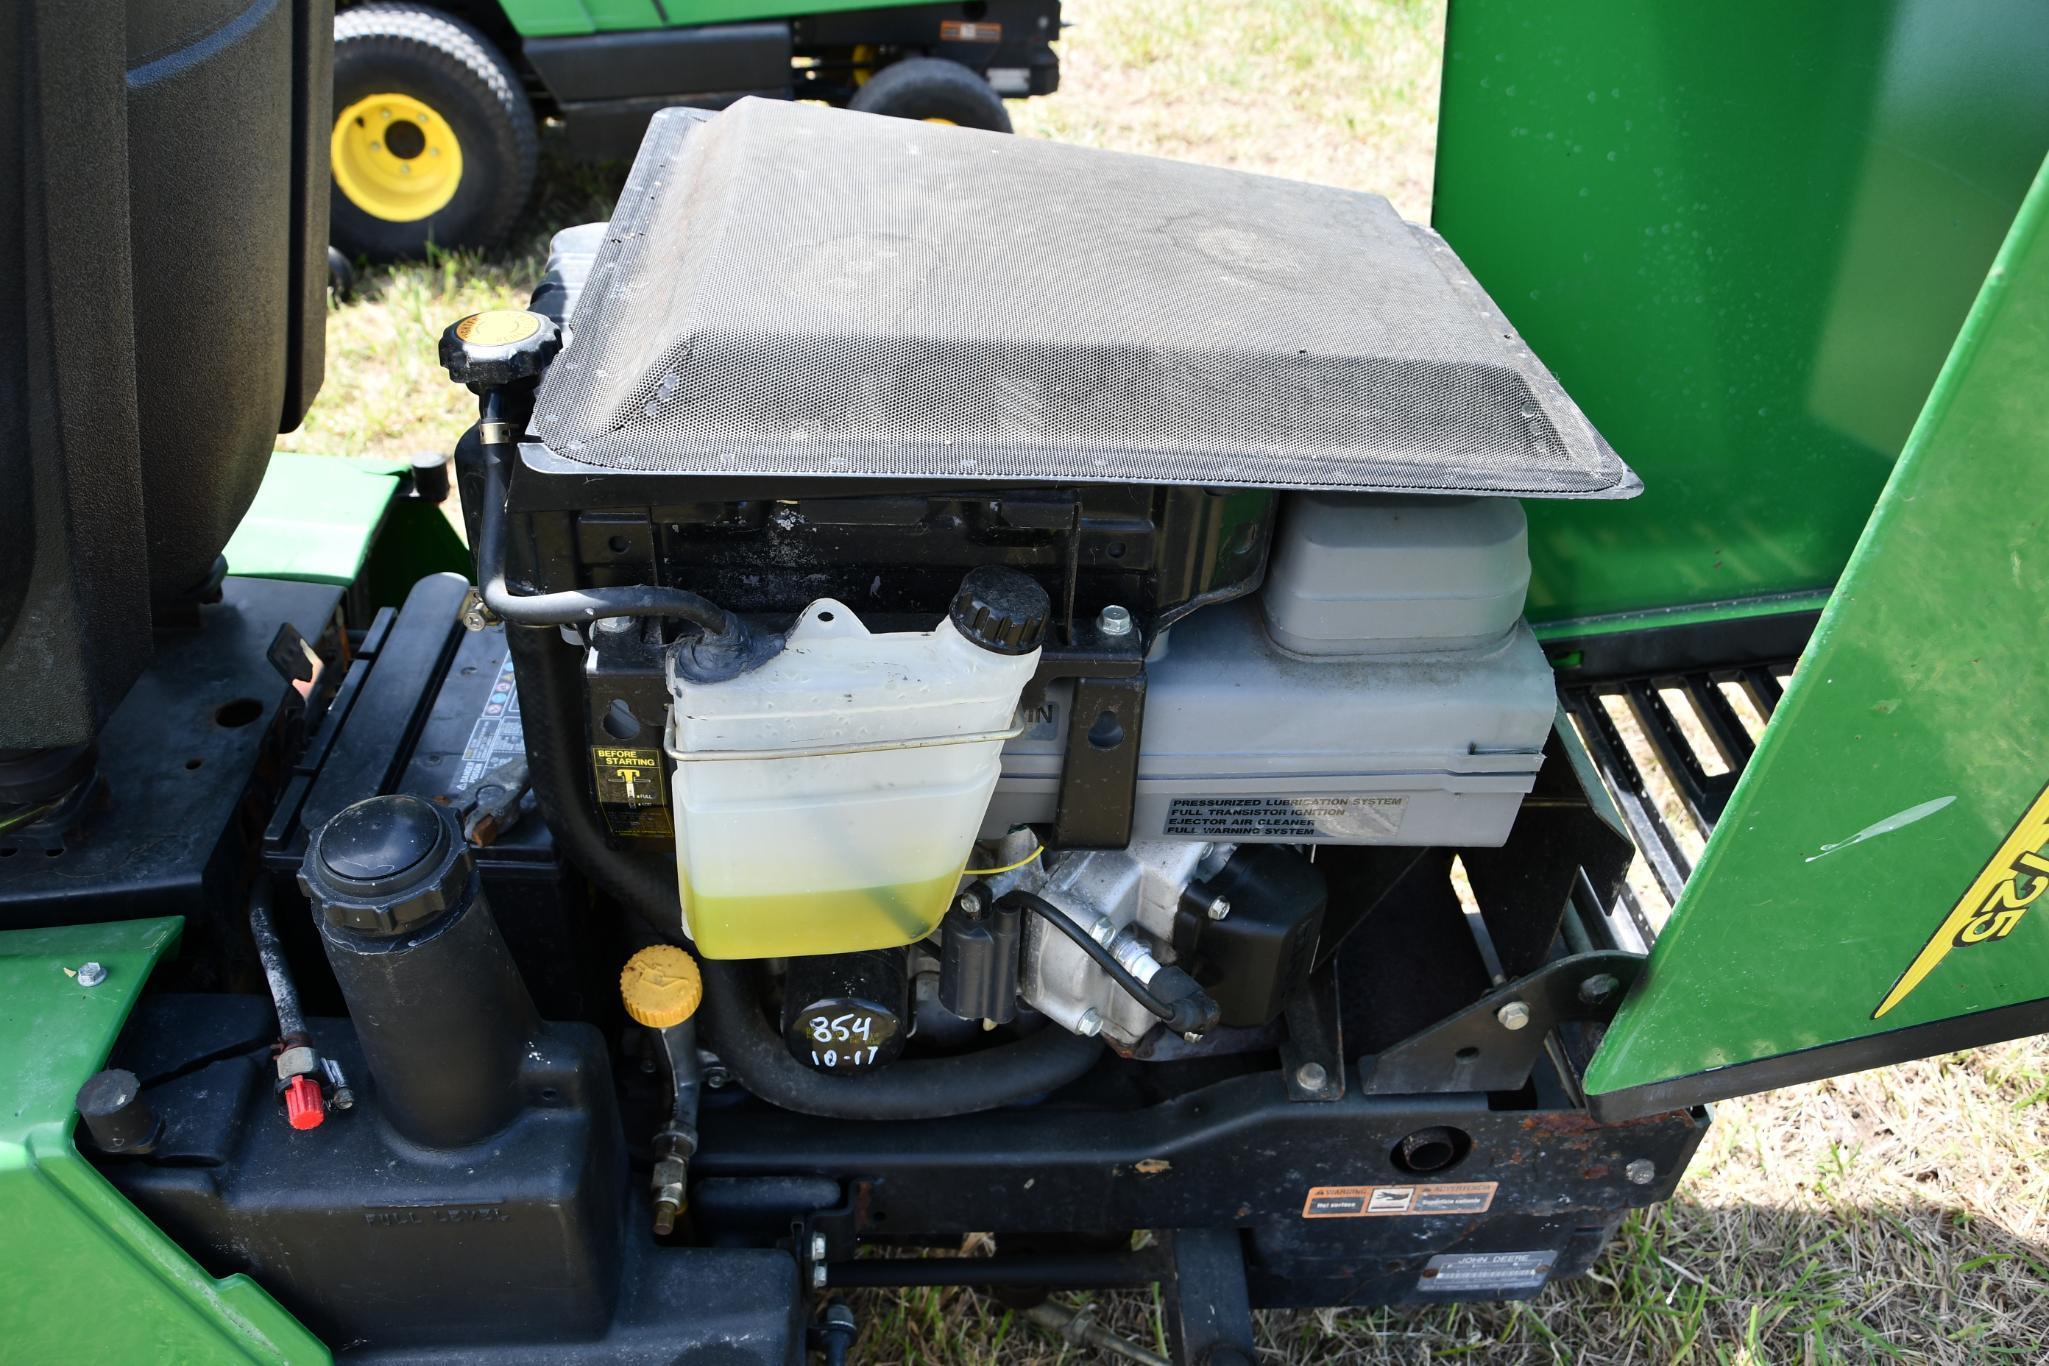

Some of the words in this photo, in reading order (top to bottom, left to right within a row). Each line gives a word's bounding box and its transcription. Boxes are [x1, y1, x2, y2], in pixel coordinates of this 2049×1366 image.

[598, 750, 637, 758] BEFORE
[606, 758, 655, 766] STARTING
[1173, 799, 1262, 807] PRESSURIZED
[1266, 798, 1348, 806] LUBRICATION
[1353, 798, 1402, 806] SYSTEM
[1290, 808, 1346, 816] IGNITION
[1257, 818, 1315, 826] CLEANER
[1203, 827, 1260, 835] WARNING
[809, 1013, 872, 1042] 854
[1458, 1256, 1488, 1264] JOHN
[1492, 1254, 1530, 1263] DEERE
